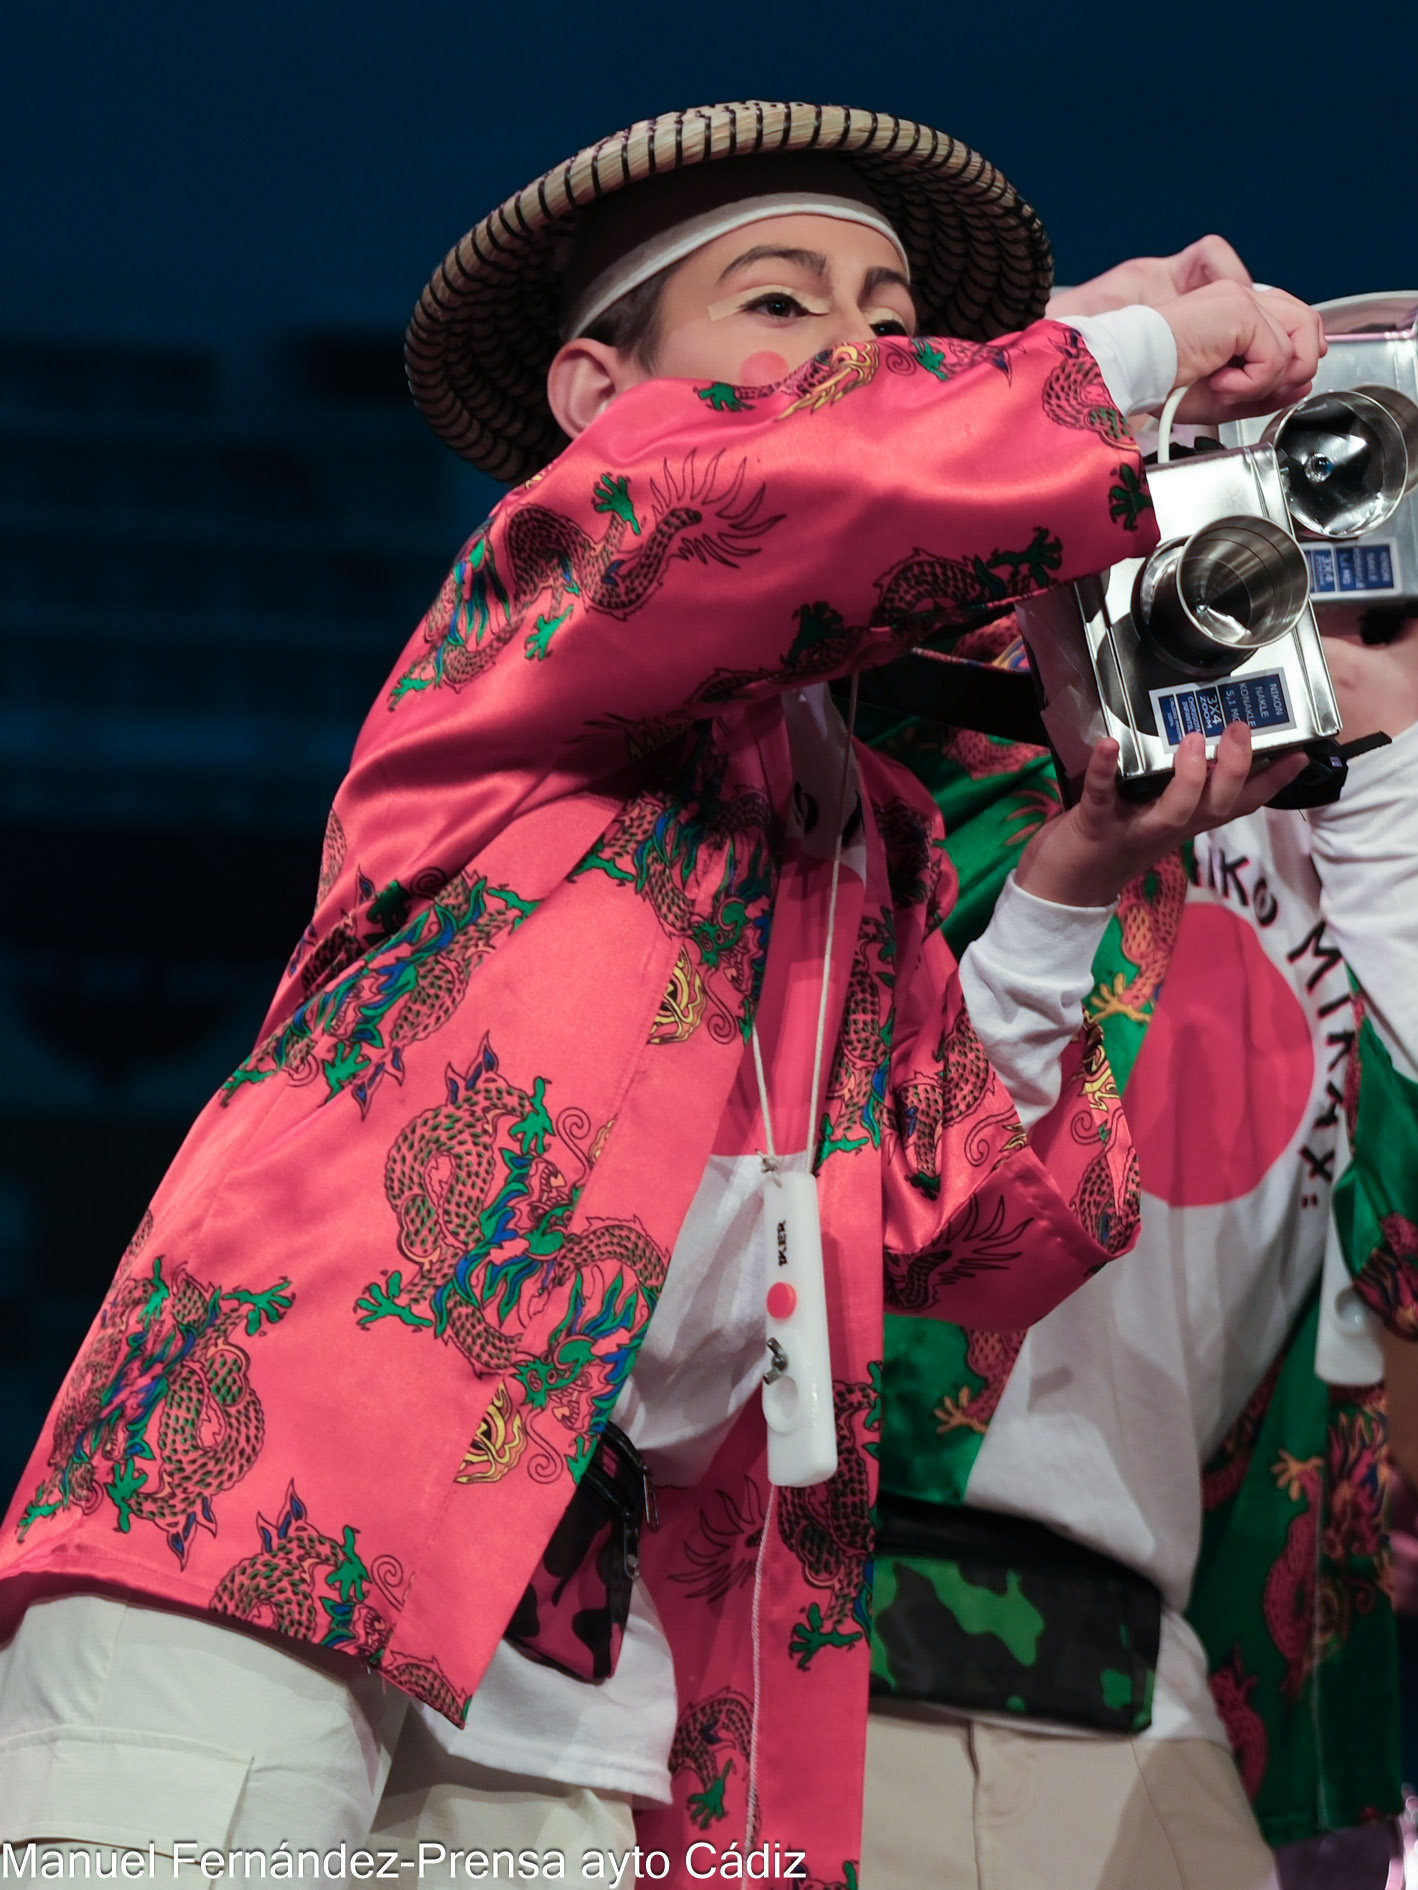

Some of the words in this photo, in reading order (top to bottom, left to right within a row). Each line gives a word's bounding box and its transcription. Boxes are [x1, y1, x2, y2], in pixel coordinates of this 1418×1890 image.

[1200, 696, 1213, 729] ZOOM
[1207, 695, 1223, 725] 3X4
[1226, 690, 1237, 705] 5,1
[1239, 682, 1256, 728] KONAKLE
[1255, 686, 1269, 719] NAKLE
[1269, 683, 1284, 716] NIKON
